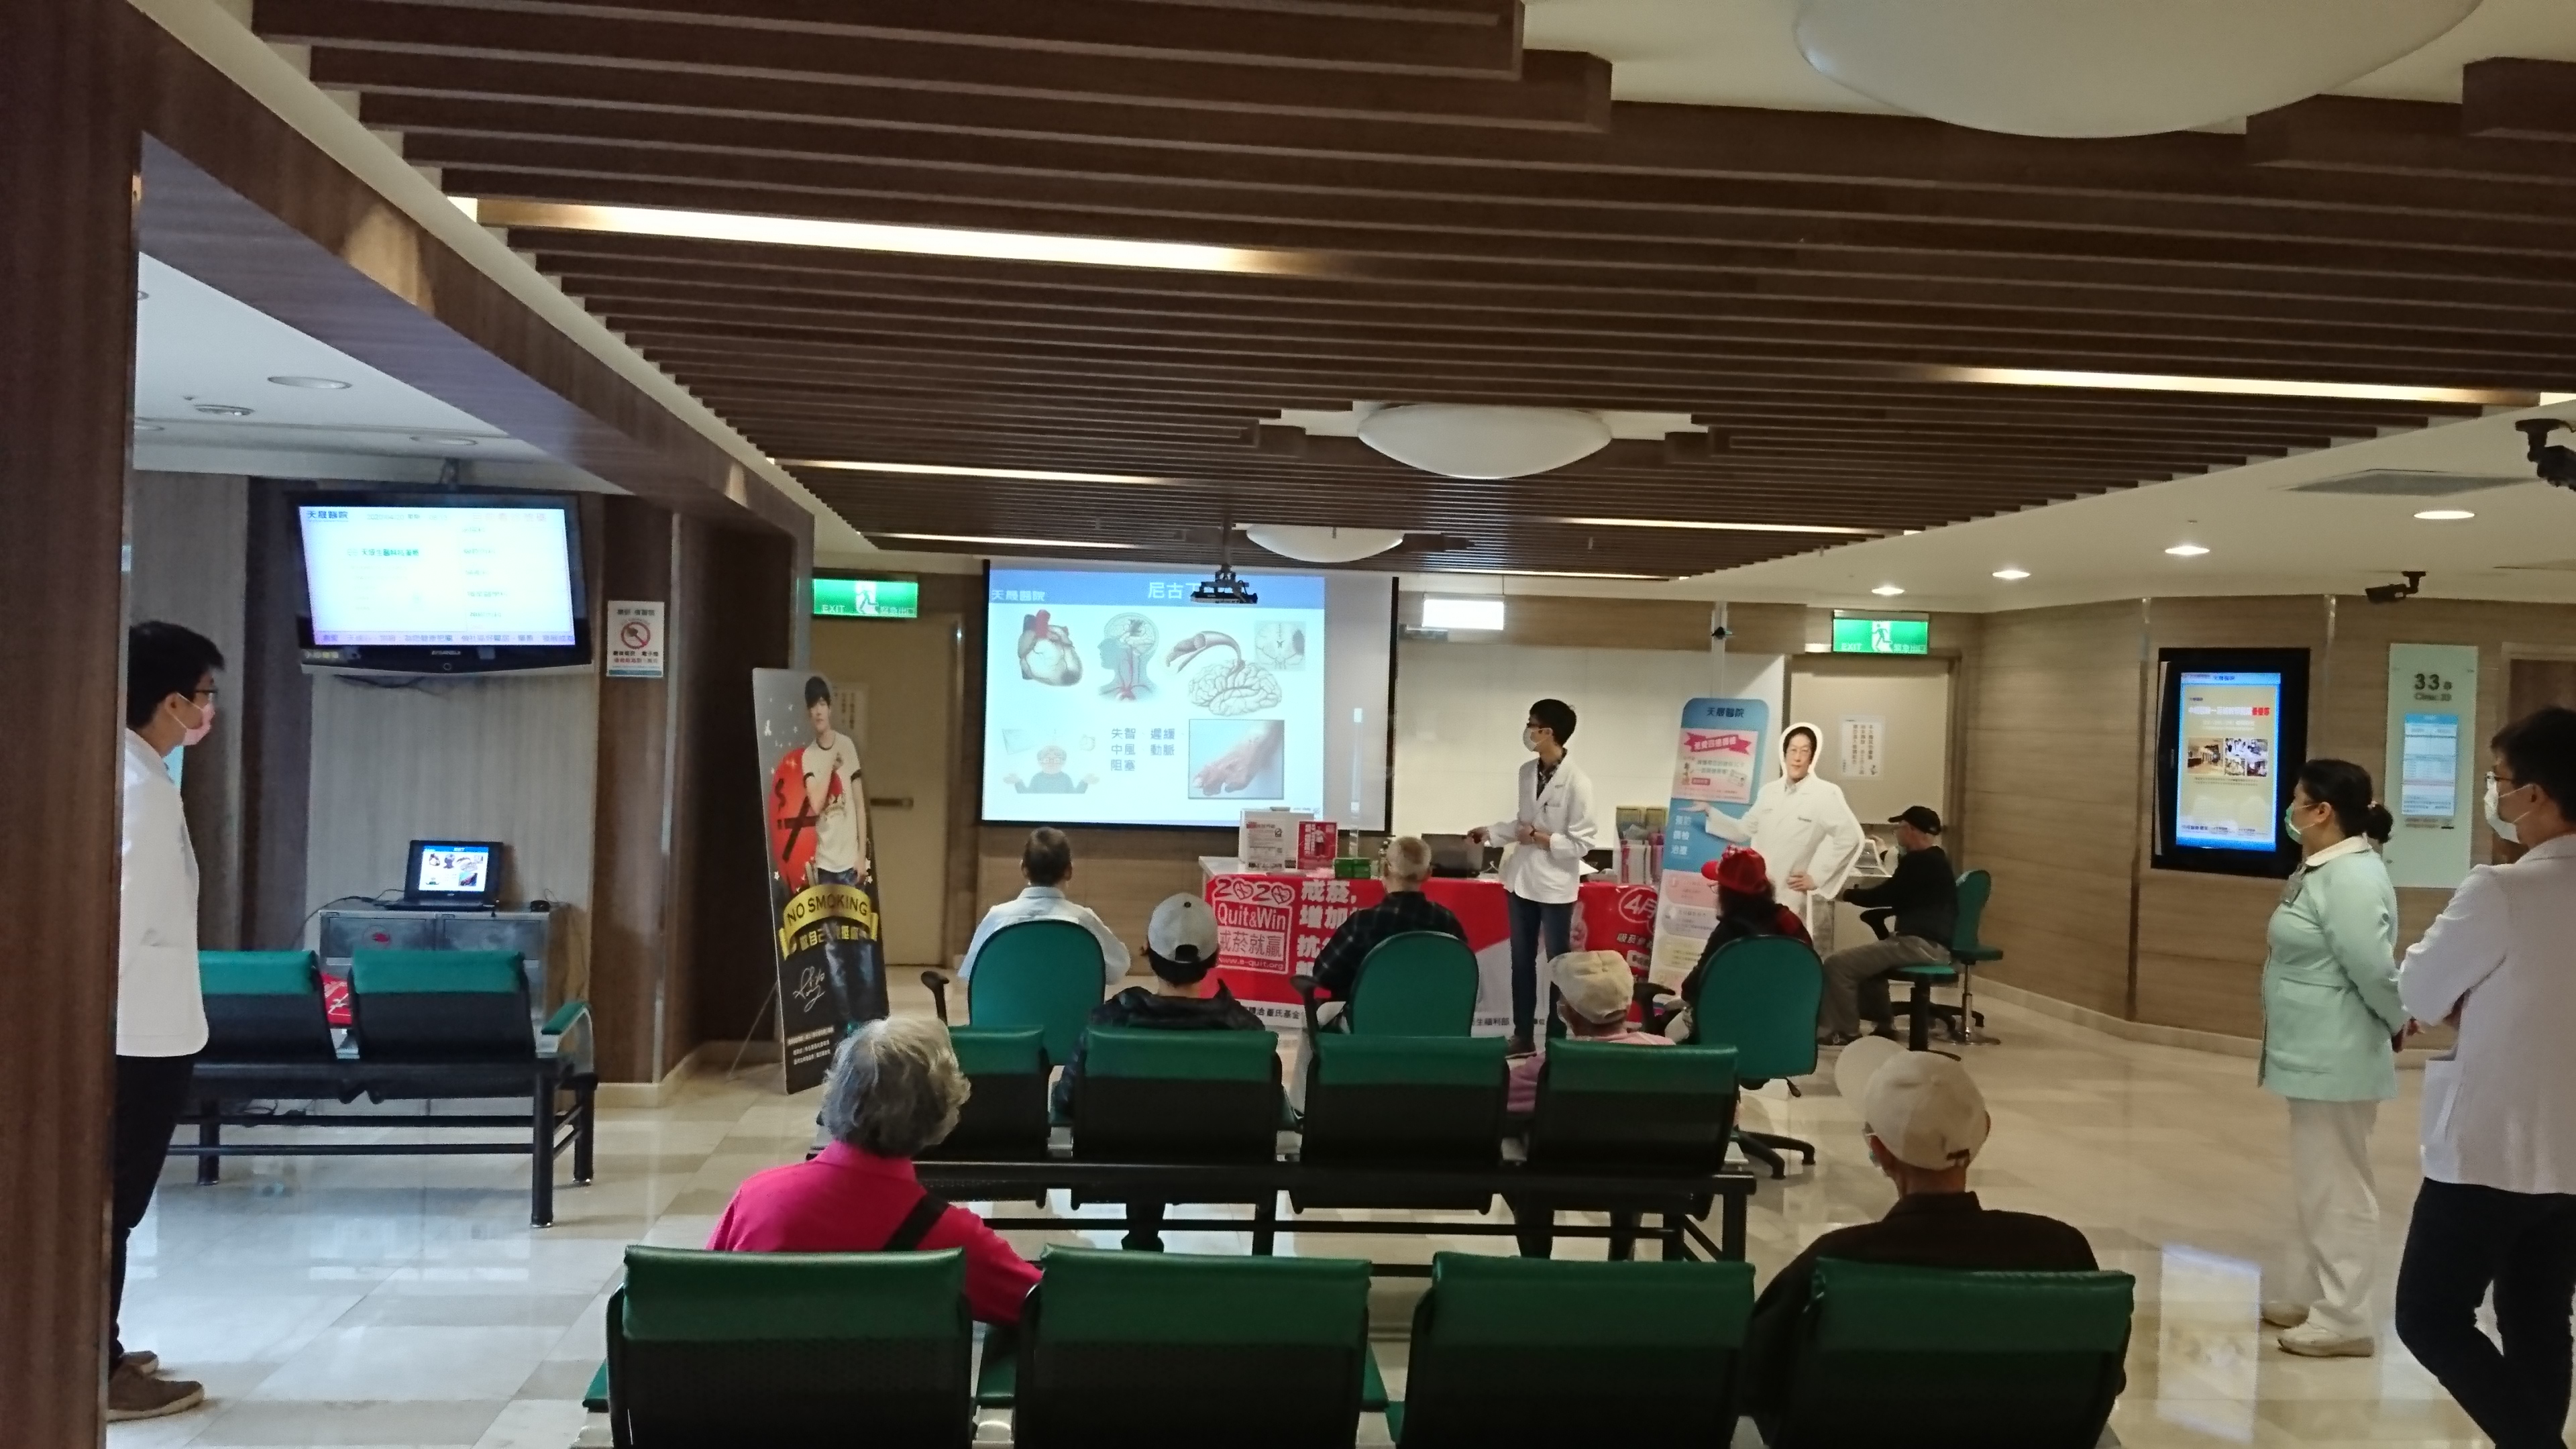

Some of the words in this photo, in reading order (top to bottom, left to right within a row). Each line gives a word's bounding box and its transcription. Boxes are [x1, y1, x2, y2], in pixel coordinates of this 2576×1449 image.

[991, 590, 1045, 602] 天晟醫院
[822, 604, 845, 613] EXIT
[1841, 643, 1862, 651] EXIT
[1707, 707, 1744, 718] 天晟醫院
[1111, 759, 1136, 771] 阻塞
[787, 902, 805, 926] NO
[808, 893, 869, 916] SMOKING
[1218, 902, 1286, 930] Quit&Win
[1299, 906, 1358, 929] 增加
[1220, 930, 1282, 957] 戒菸就贏
